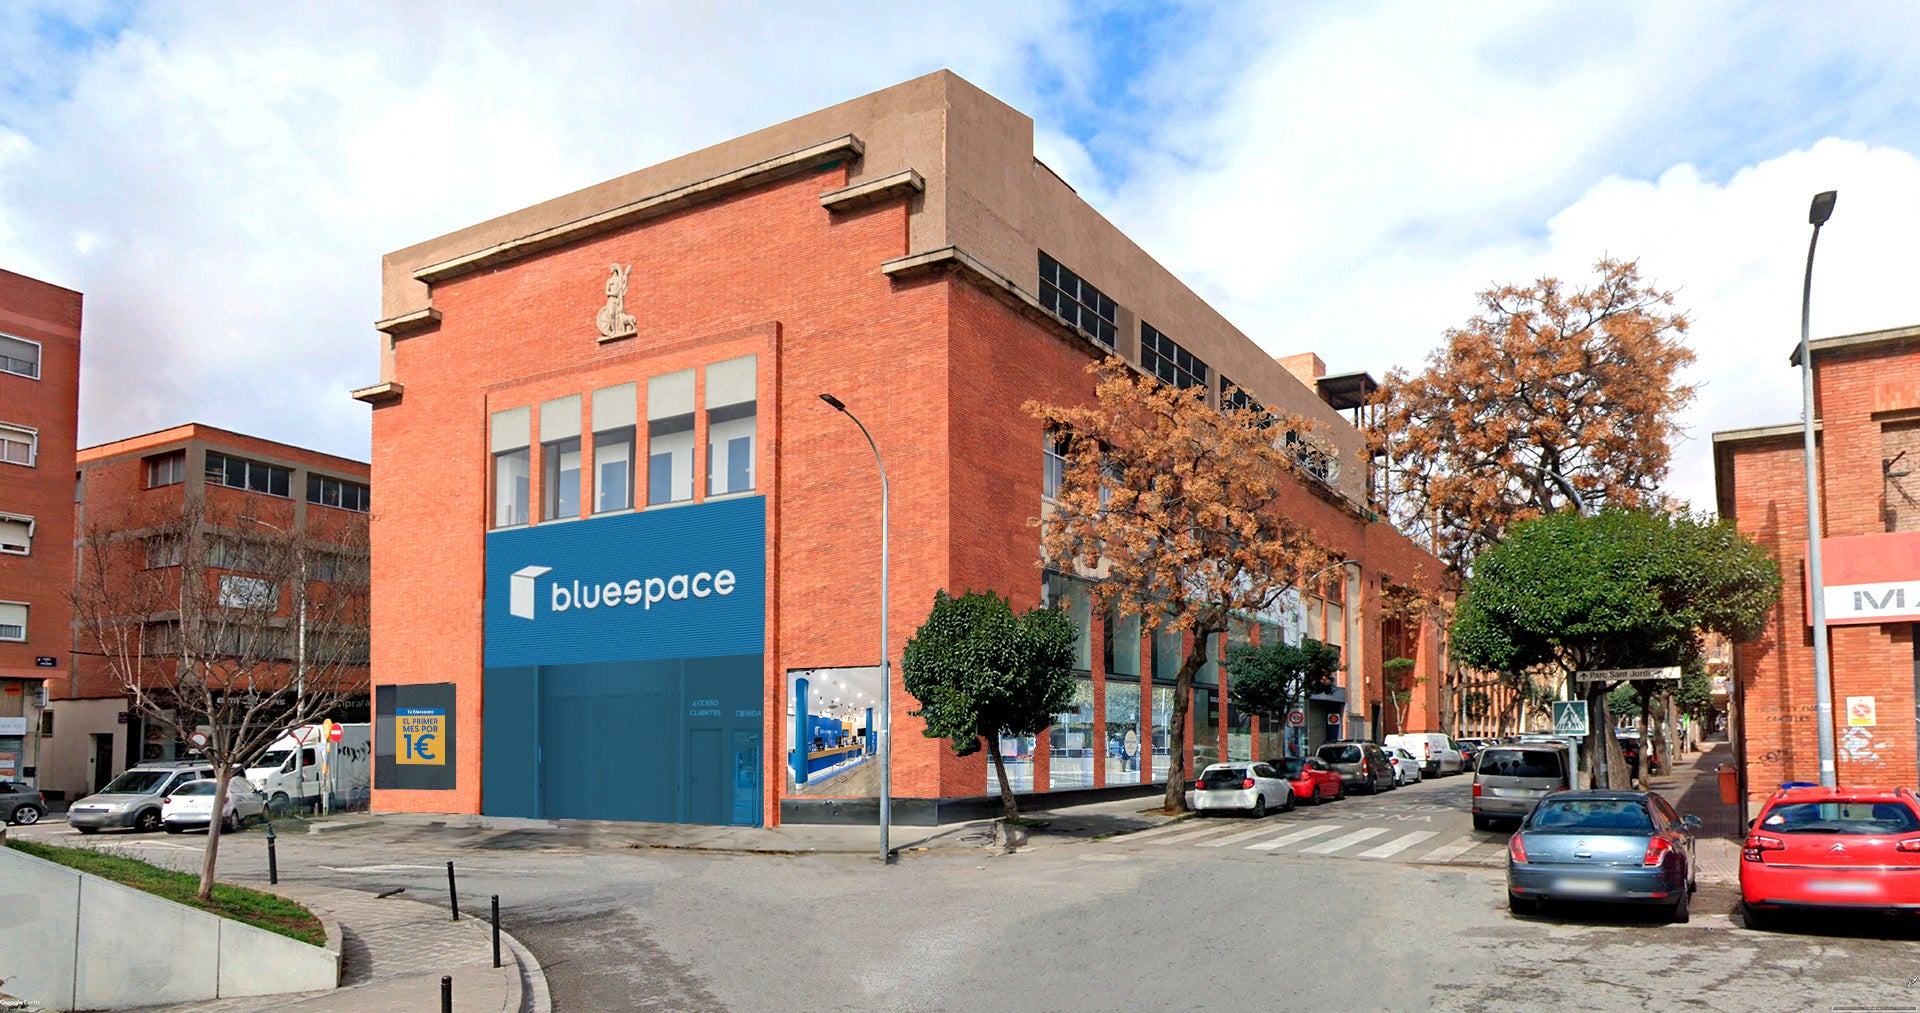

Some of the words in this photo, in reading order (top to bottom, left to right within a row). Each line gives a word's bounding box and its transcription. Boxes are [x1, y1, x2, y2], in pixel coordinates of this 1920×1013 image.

[552, 569, 736, 612] bluespace
[1589, 671, 1607, 680] Parc
[1609, 669, 1628, 679] Sant
[1630, 668, 1651, 678] Jordi
[691, 699, 719, 708] ACCESO
[689, 709, 722, 717] CLIENTES
[735, 709, 762, 717] TIENDA
[403, 734, 436, 760] 1€
